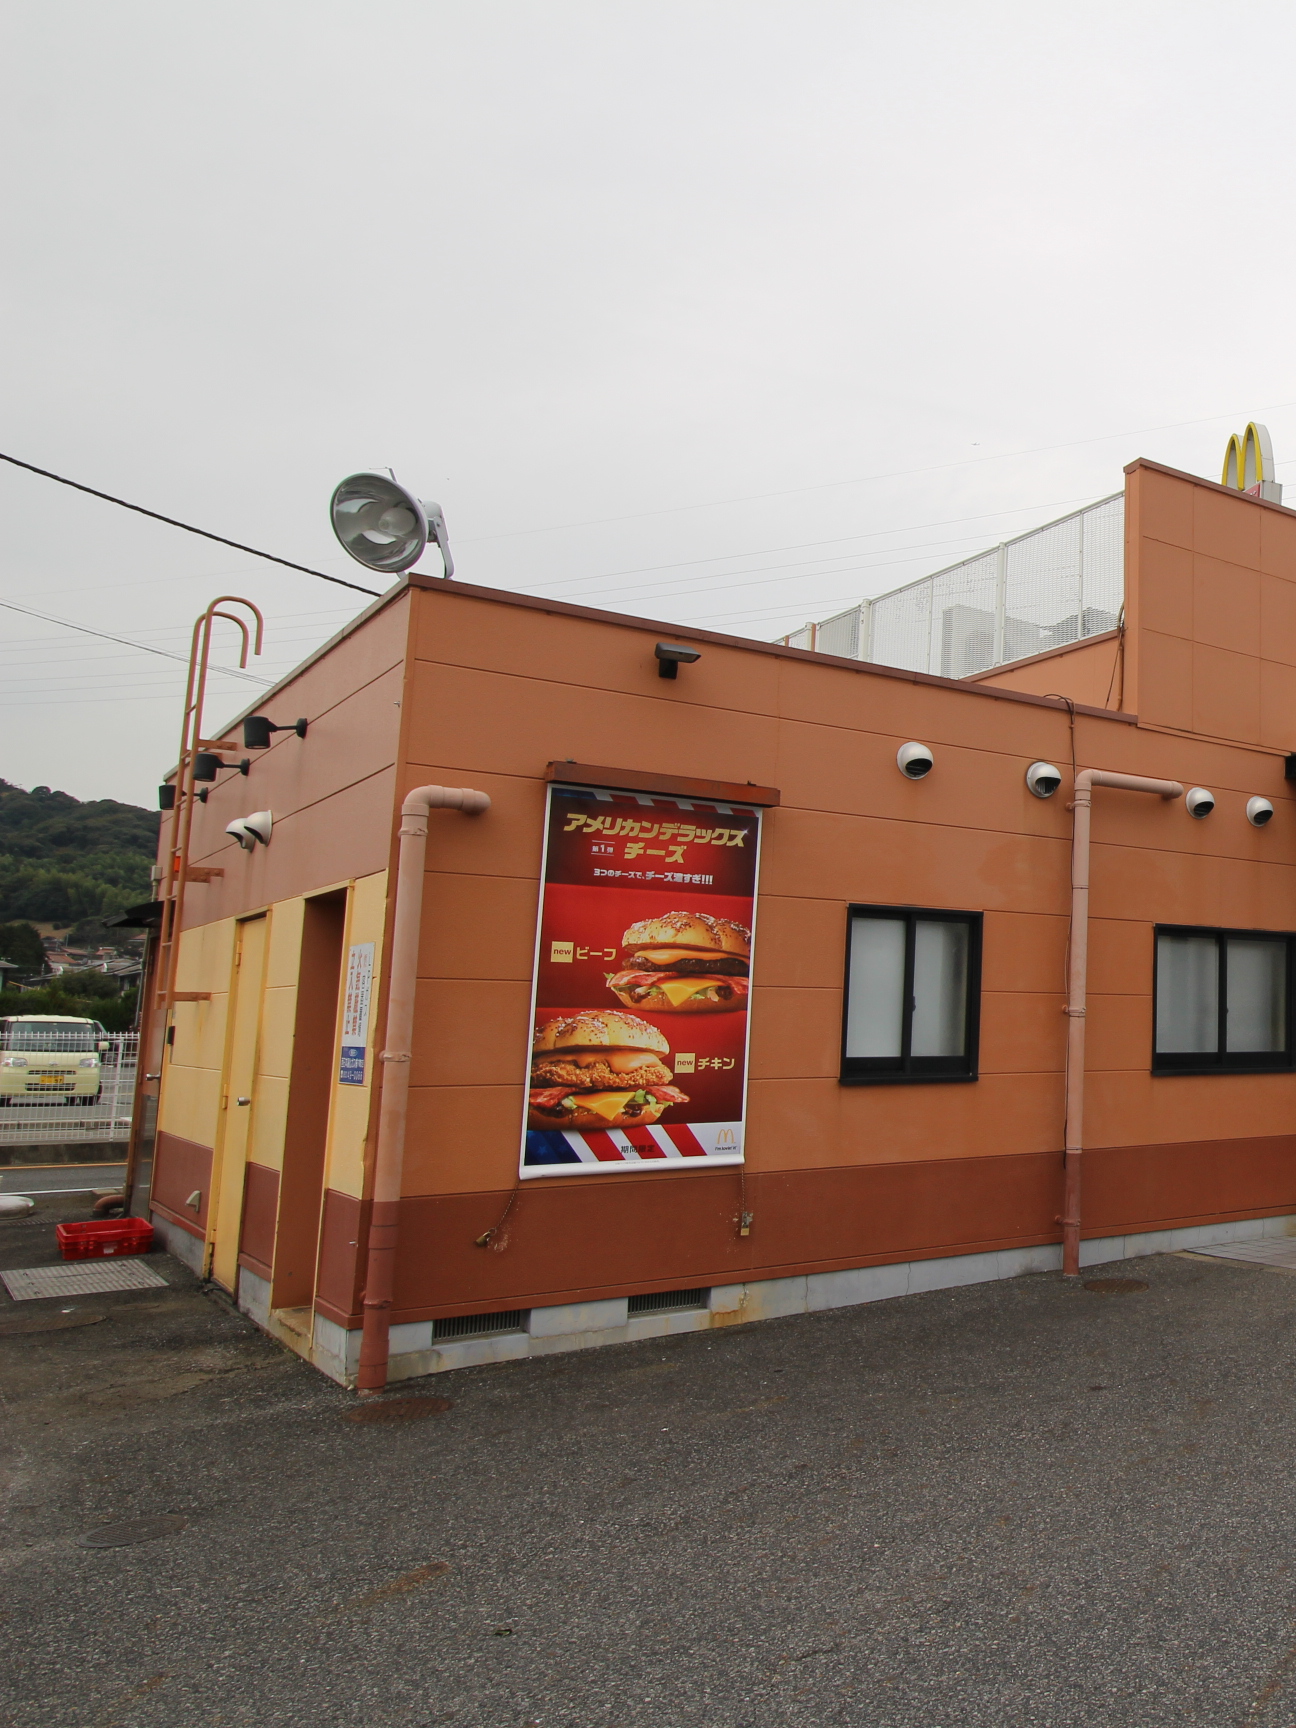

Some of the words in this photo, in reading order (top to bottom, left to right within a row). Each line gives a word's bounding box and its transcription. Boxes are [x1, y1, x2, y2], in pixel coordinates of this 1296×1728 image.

[563, 813, 746, 847] アメリカンデラックス
[624, 842, 687, 863] チーズ
[576, 946, 617, 960] ビーフ
[698, 1057, 735, 1070] チキン
